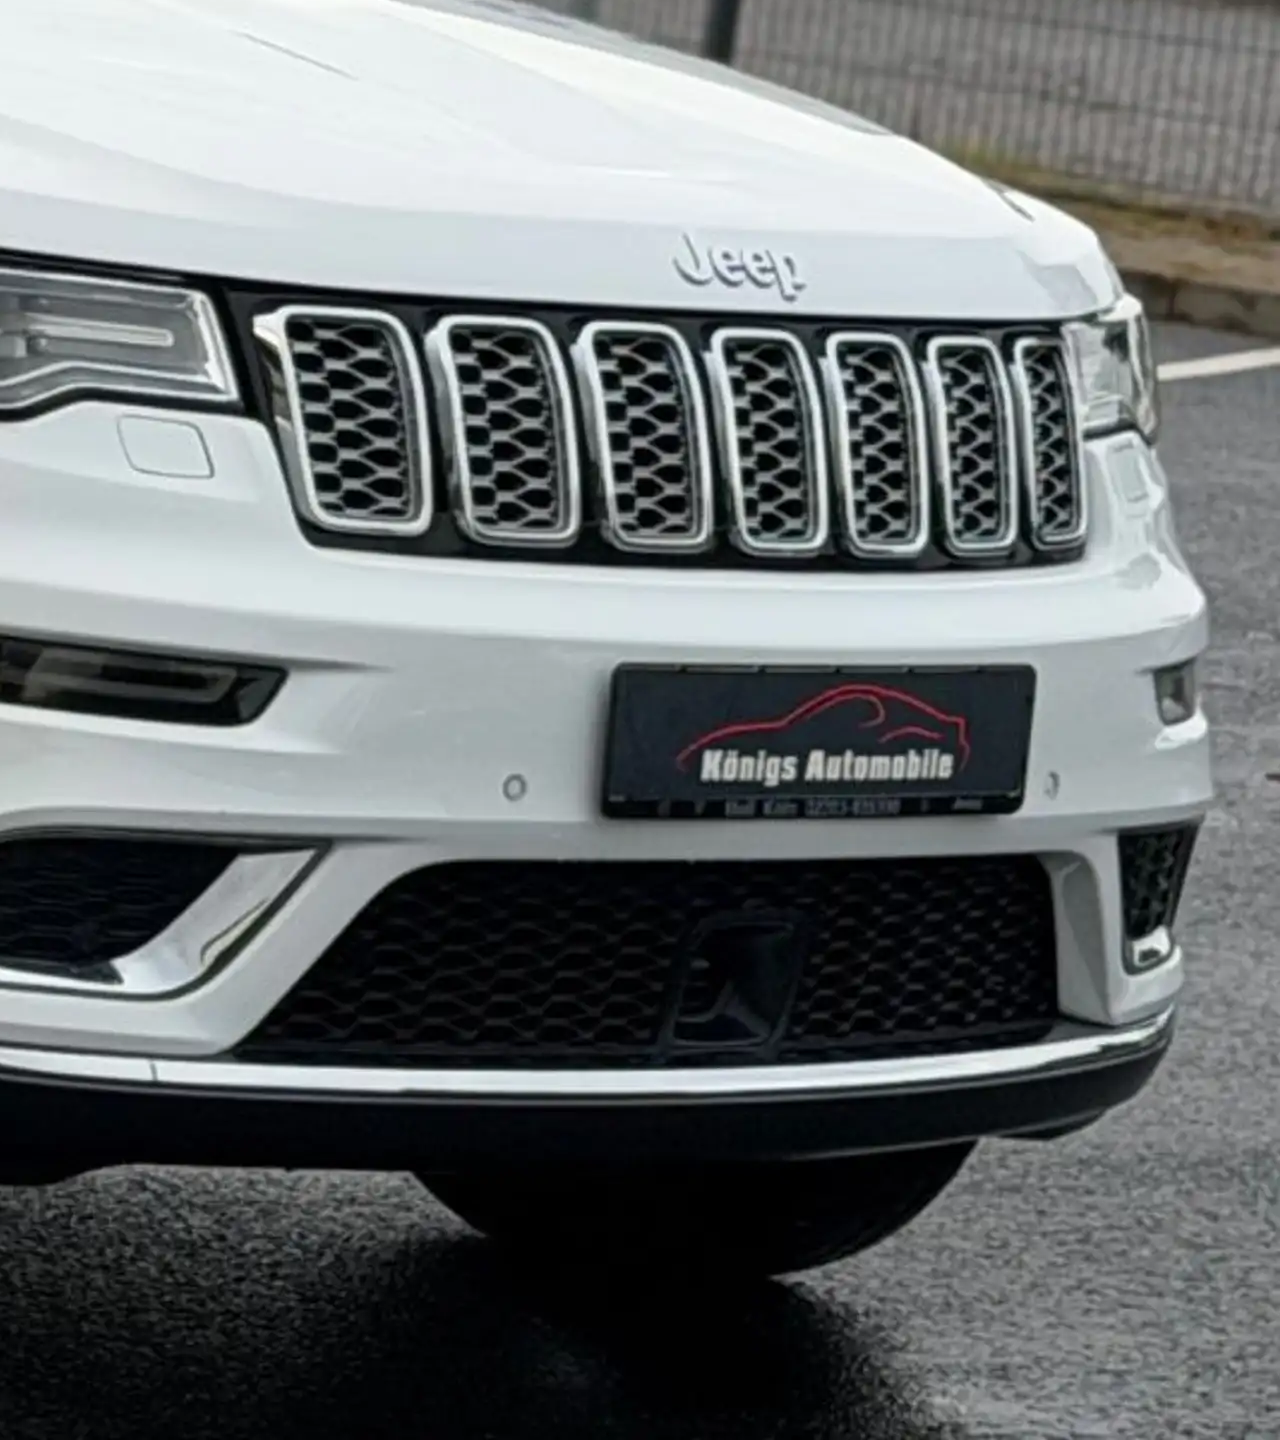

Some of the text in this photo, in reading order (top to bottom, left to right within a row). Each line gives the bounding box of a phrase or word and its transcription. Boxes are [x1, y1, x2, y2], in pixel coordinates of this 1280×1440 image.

[673, 232, 806, 302] Jeep
[700, 749, 955, 787] Königs Automobile
